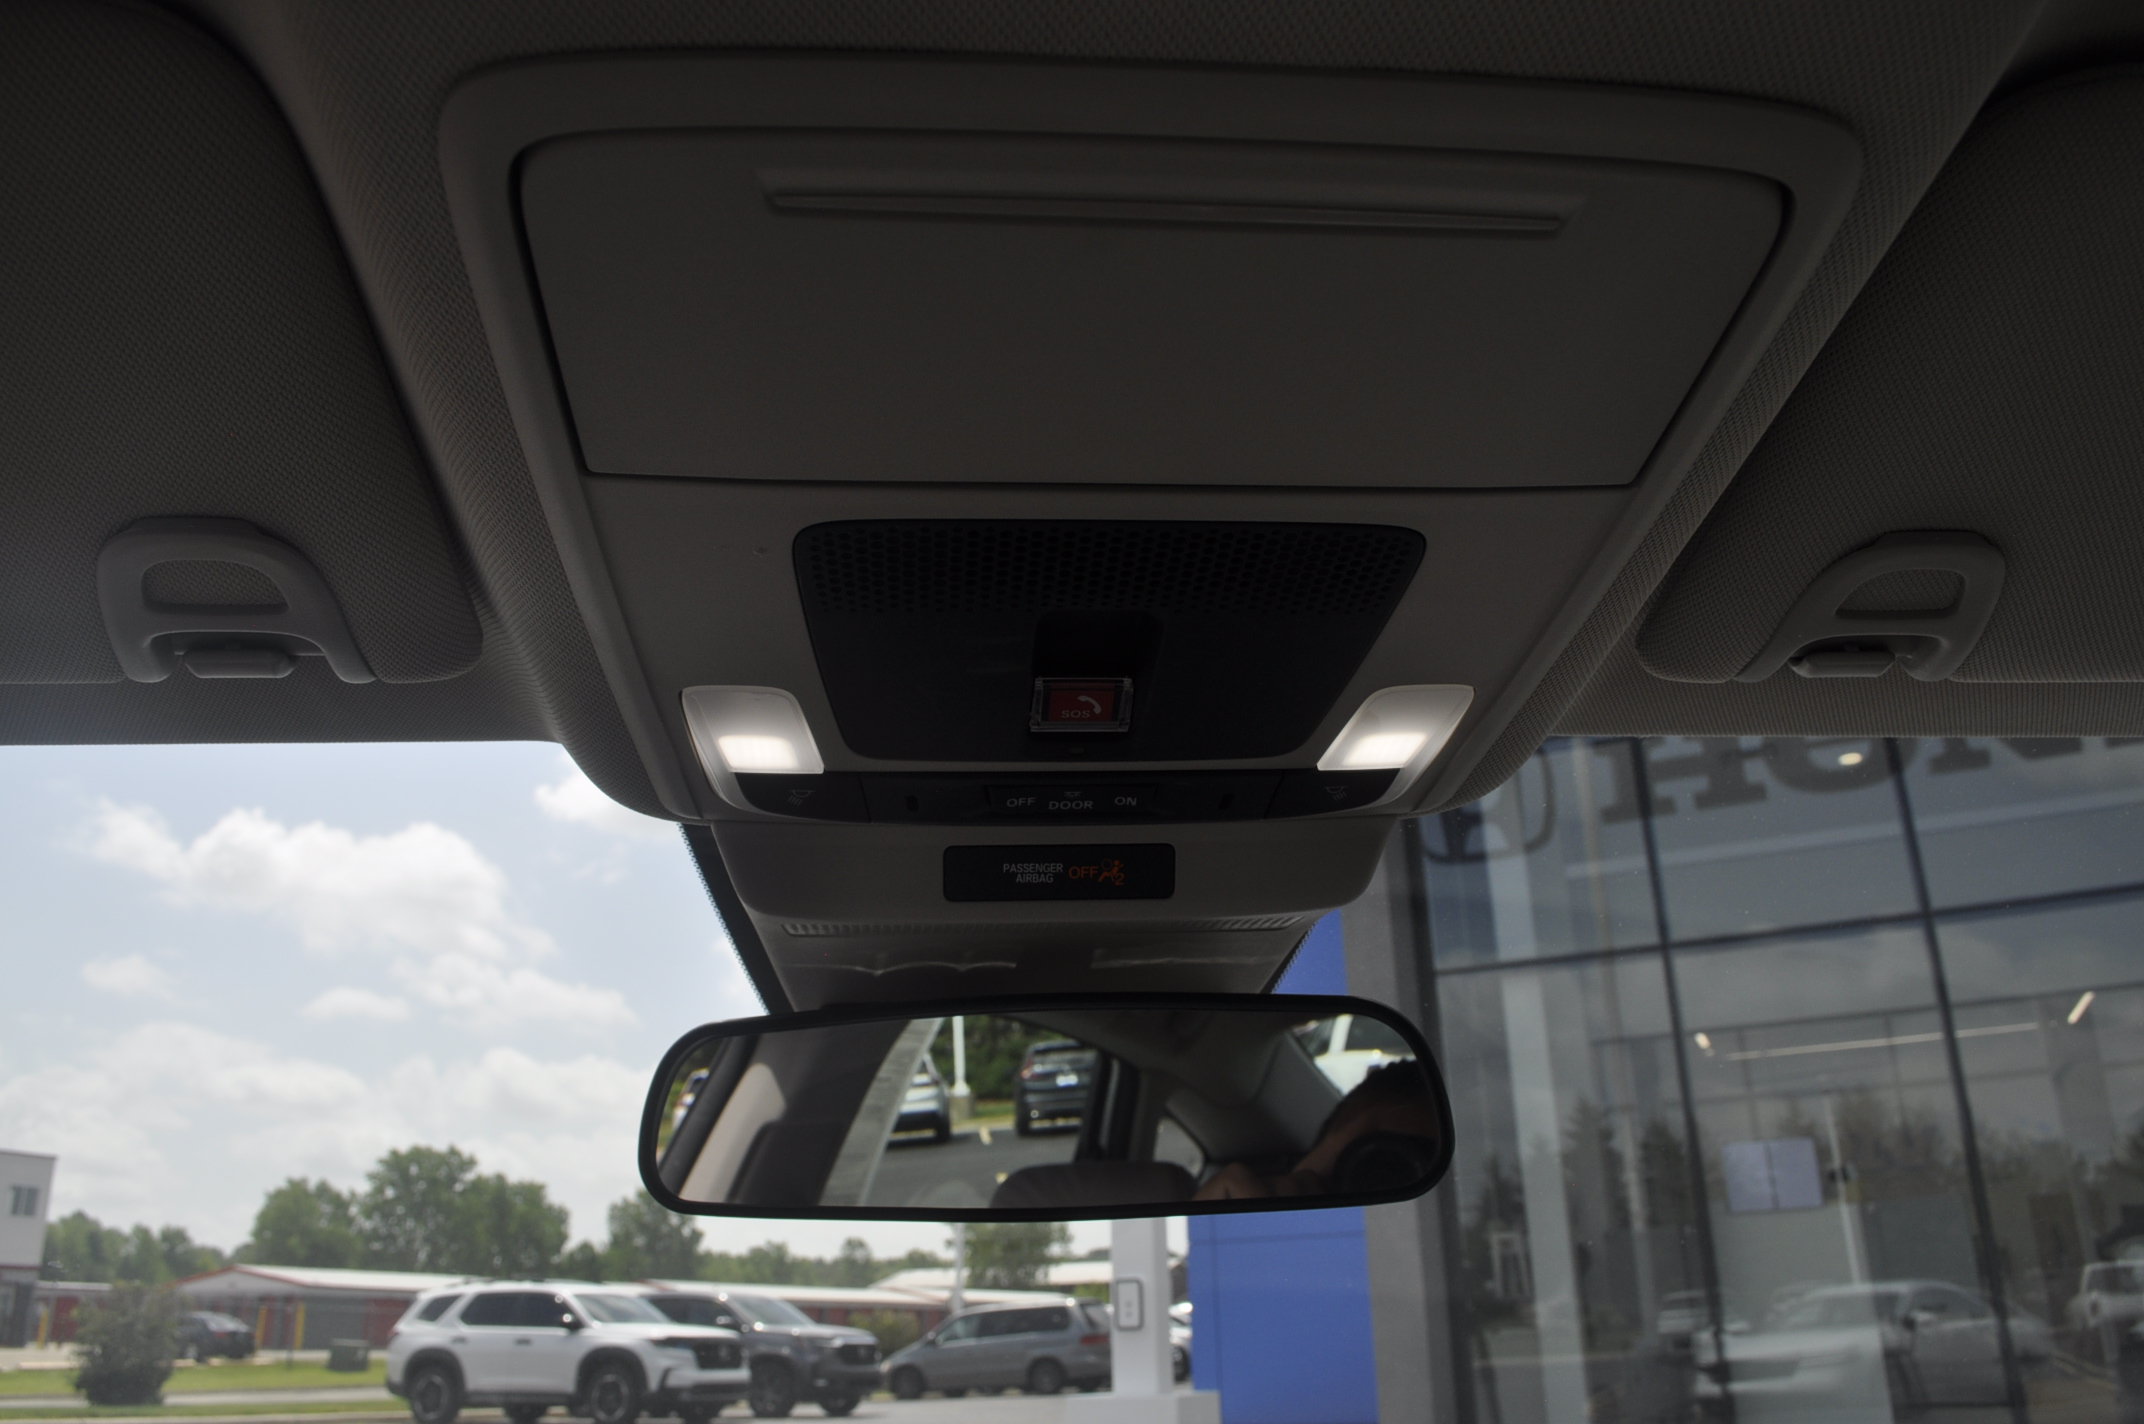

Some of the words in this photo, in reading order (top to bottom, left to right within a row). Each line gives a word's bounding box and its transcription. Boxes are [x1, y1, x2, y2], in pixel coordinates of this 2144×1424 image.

[1061, 708, 1091, 720] SOS
[1006, 797, 1037, 808] OFF
[1048, 800, 1095, 811] DOOR
[1114, 796, 1138, 807] ON
[1003, 862, 1064, 874] PASSENGER
[1067, 867, 1099, 880] OFF
[1015, 873, 1055, 884] AIRBAG
